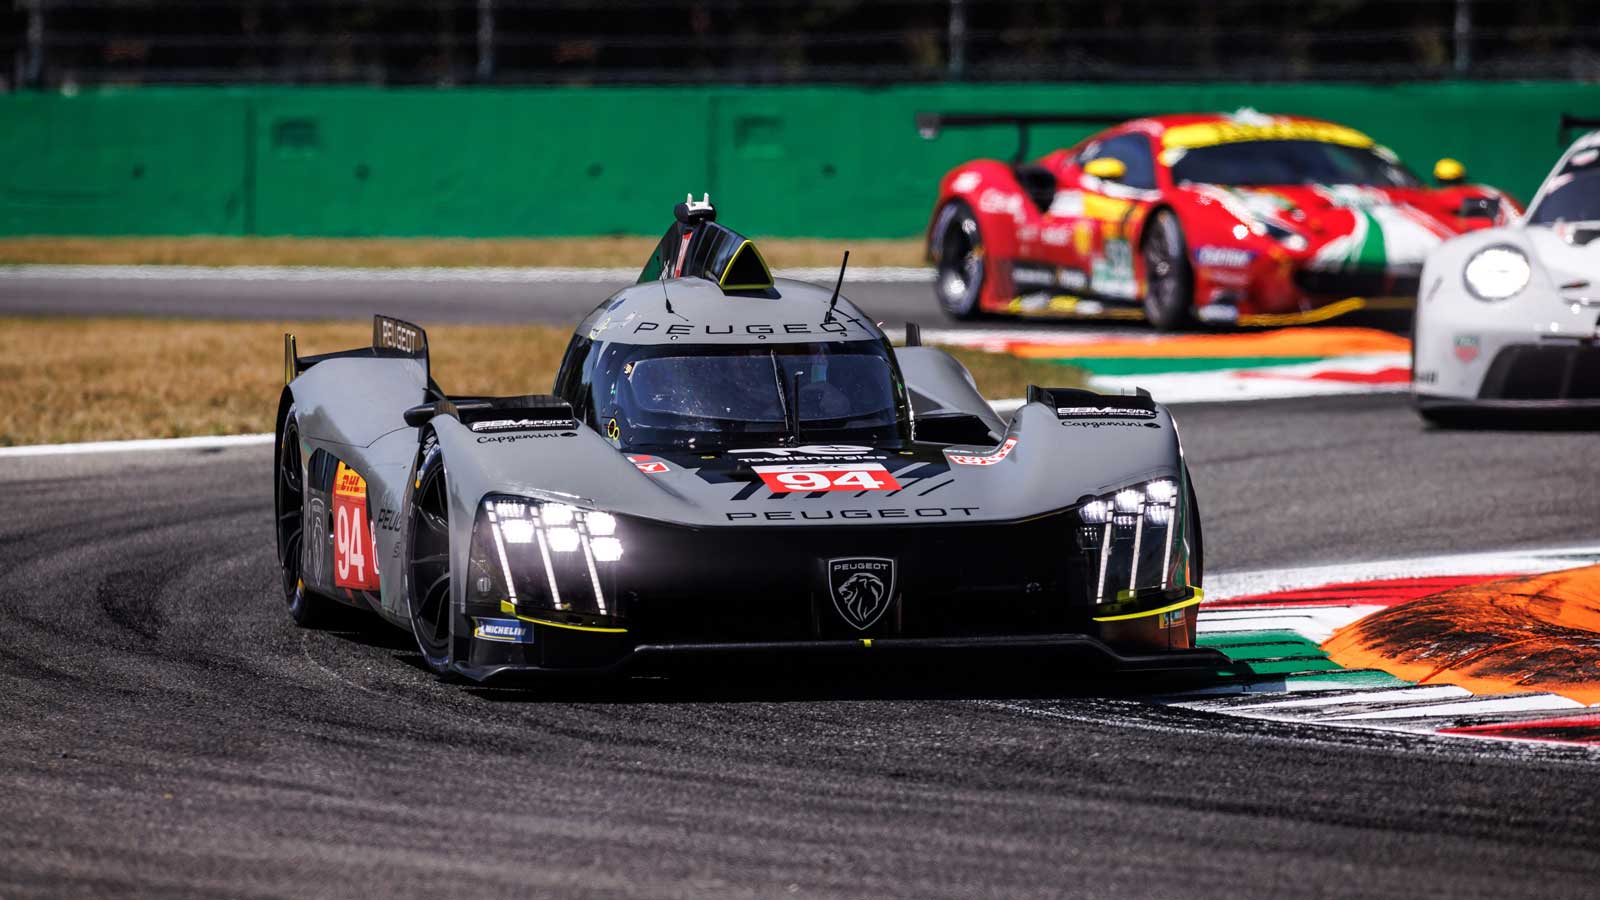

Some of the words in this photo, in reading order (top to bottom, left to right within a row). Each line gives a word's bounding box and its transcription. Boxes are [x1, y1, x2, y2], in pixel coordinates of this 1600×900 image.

[383, 320, 416, 354] PEUGEOT
[1061, 420, 1143, 428] Capgemini
[476, 431, 559, 444] Capgemini
[737, 455, 888, 463] TotalEnergies
[341, 475, 360, 492] DHL
[776, 471, 885, 490] 94
[725, 507, 981, 521] PEUGEOT
[337, 505, 365, 582] 94
[833, 562, 889, 571] PEUGEOT
[485, 625, 527, 636] MICHELIN
